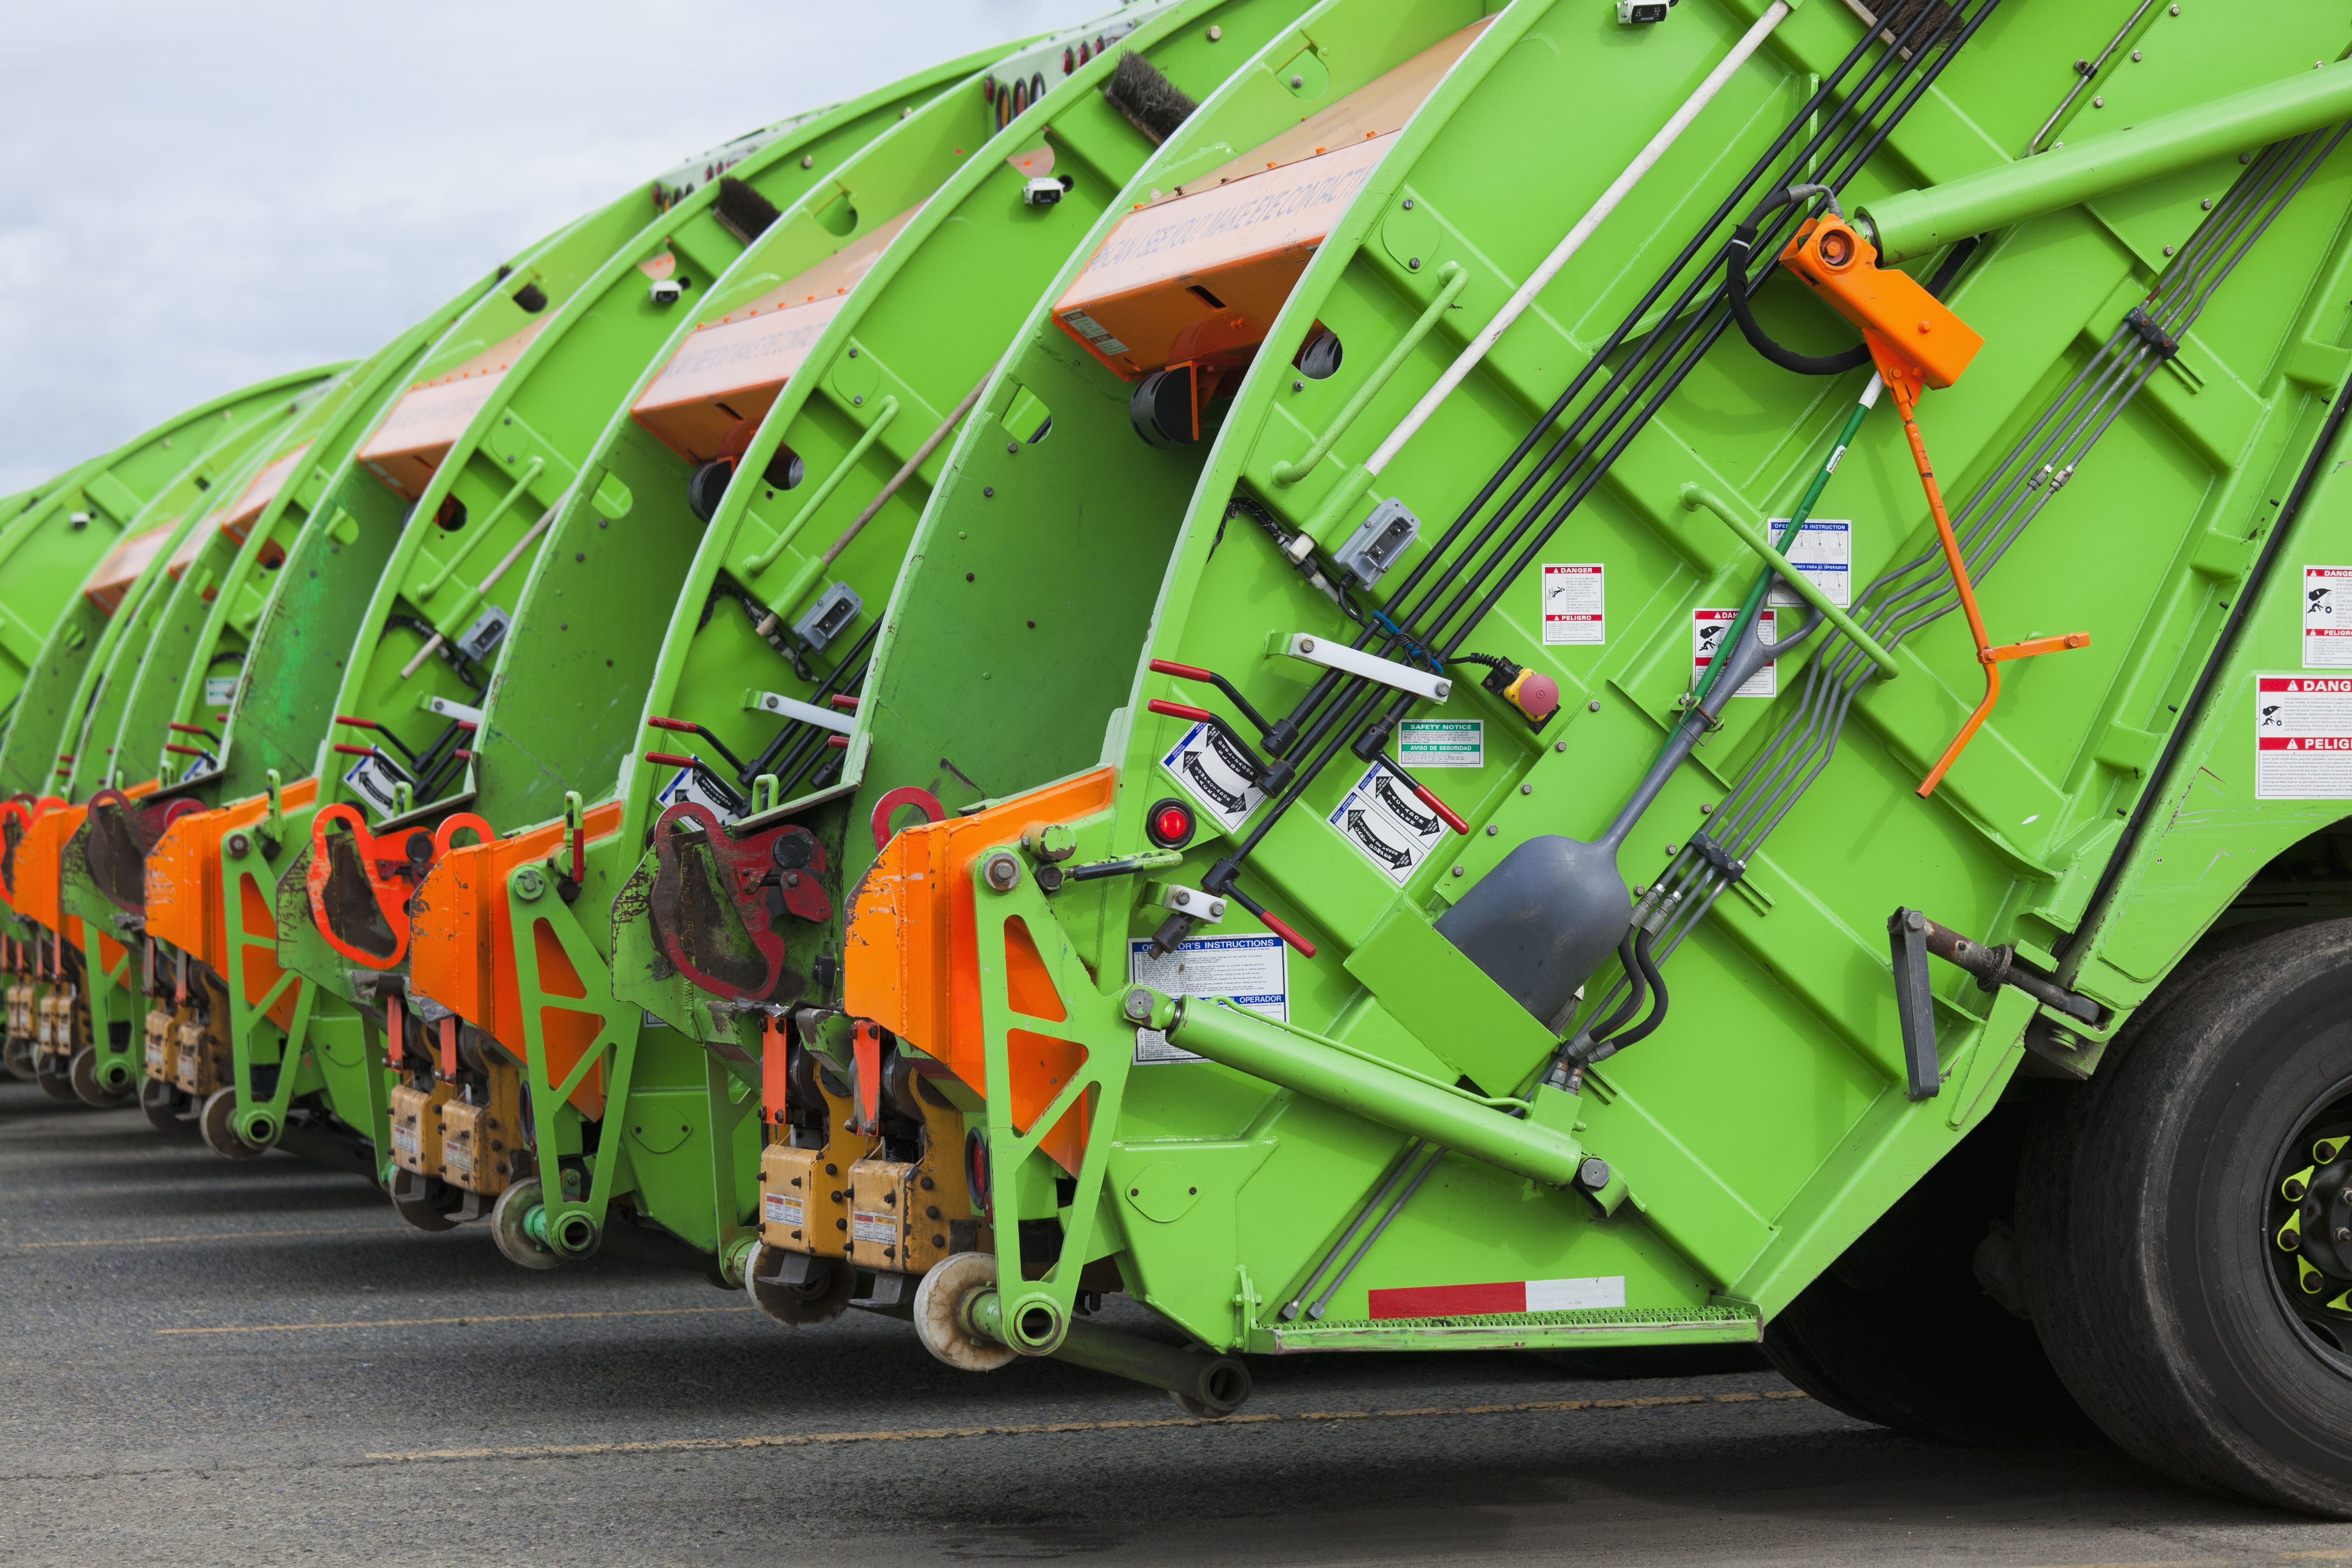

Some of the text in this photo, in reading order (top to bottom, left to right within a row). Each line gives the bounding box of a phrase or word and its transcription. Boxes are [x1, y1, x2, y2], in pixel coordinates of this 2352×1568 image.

[1199, 201, 1259, 240] MAKE
[1243, 189, 1287, 226] EYE
[2303, 680, 2351, 691] DANG
[2305, 739, 2352, 749] PELIG
[1218, 740, 1254, 776] DESLIZADOR
[1218, 750, 1241, 772] SLIDE
[1195, 766, 1231, 801] COMPACTADOR
[1195, 776, 1222, 802] PACKER
[1386, 791, 1424, 824] VACIADOR
[1388, 800, 1415, 825] TIPPER
[1355, 827, 1393, 860] CART DUMPER
[1204, 939, 1274, 949] INSTRUCTIONS
